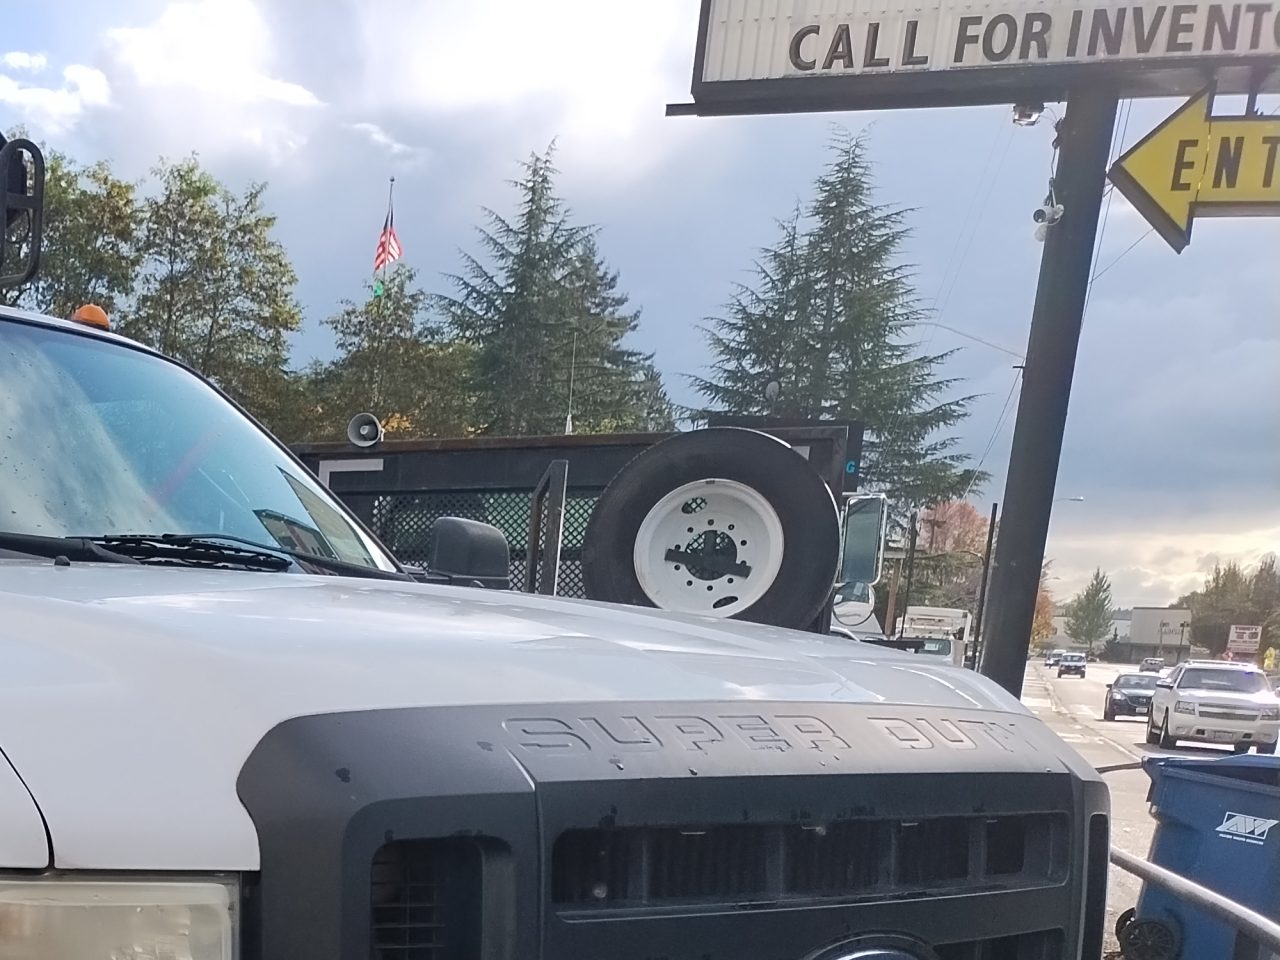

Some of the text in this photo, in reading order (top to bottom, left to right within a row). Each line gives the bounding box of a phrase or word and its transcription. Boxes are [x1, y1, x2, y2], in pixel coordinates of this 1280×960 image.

[789, 3, 1280, 71] CALL FOR INVENT
[500, 714, 1039, 755] SUPER DUTY
